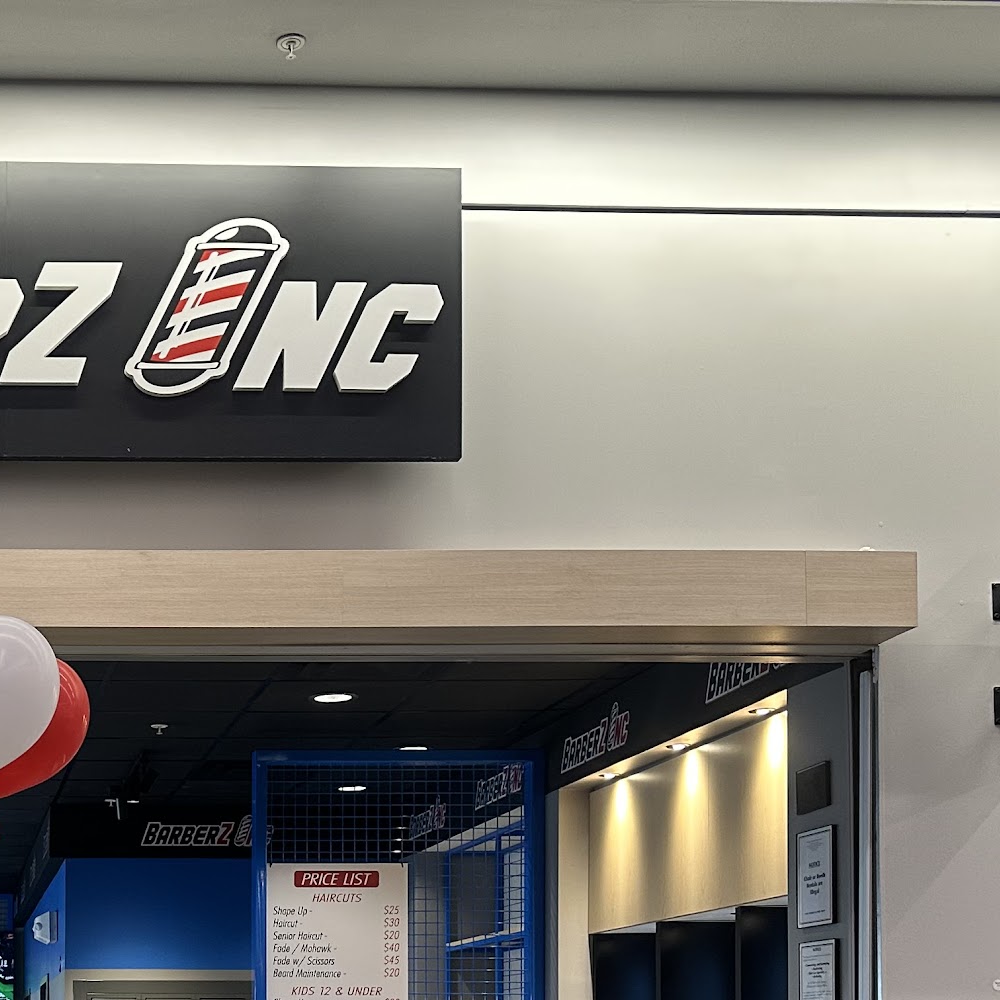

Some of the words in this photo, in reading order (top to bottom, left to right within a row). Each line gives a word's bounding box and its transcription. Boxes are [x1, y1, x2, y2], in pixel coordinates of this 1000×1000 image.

[561, 717, 608, 774] BARBERZ
[141, 822, 235, 846] BARBERZ
[301, 872, 339, 886] PRICE
[343, 872, 372, 886] LIST
[312, 893, 362, 902] HAIRCUTS
[273, 906, 295, 917] Shape
[297, 906, 308, 916] Up
[384, 905, 399, 915] $25
[273, 918, 298, 928] Haircut
[384, 918, 400, 928] $30
[273, 931, 296, 940] Senior
[298, 932, 323, 940] Haircut
[384, 930, 400, 940] $20
[273, 944, 290, 953] Fade
[301, 944, 332, 953] Mohawk
[384, 943, 400, 953] $40
[273, 956, 290, 965] Fade
[292, 957, 305, 967] w/
[307, 957, 335, 965] Scissors
[384, 955, 399, 965] $45
[273, 969, 294, 978] Beard
[296, 969, 341, 978] Maintenance
[384, 968, 400, 978] $20
[291, 987, 315, 995] KIDS
[320, 987, 331, 995] 12
[336, 987, 343, 995] &
[348, 987, 383, 995] UNDER
